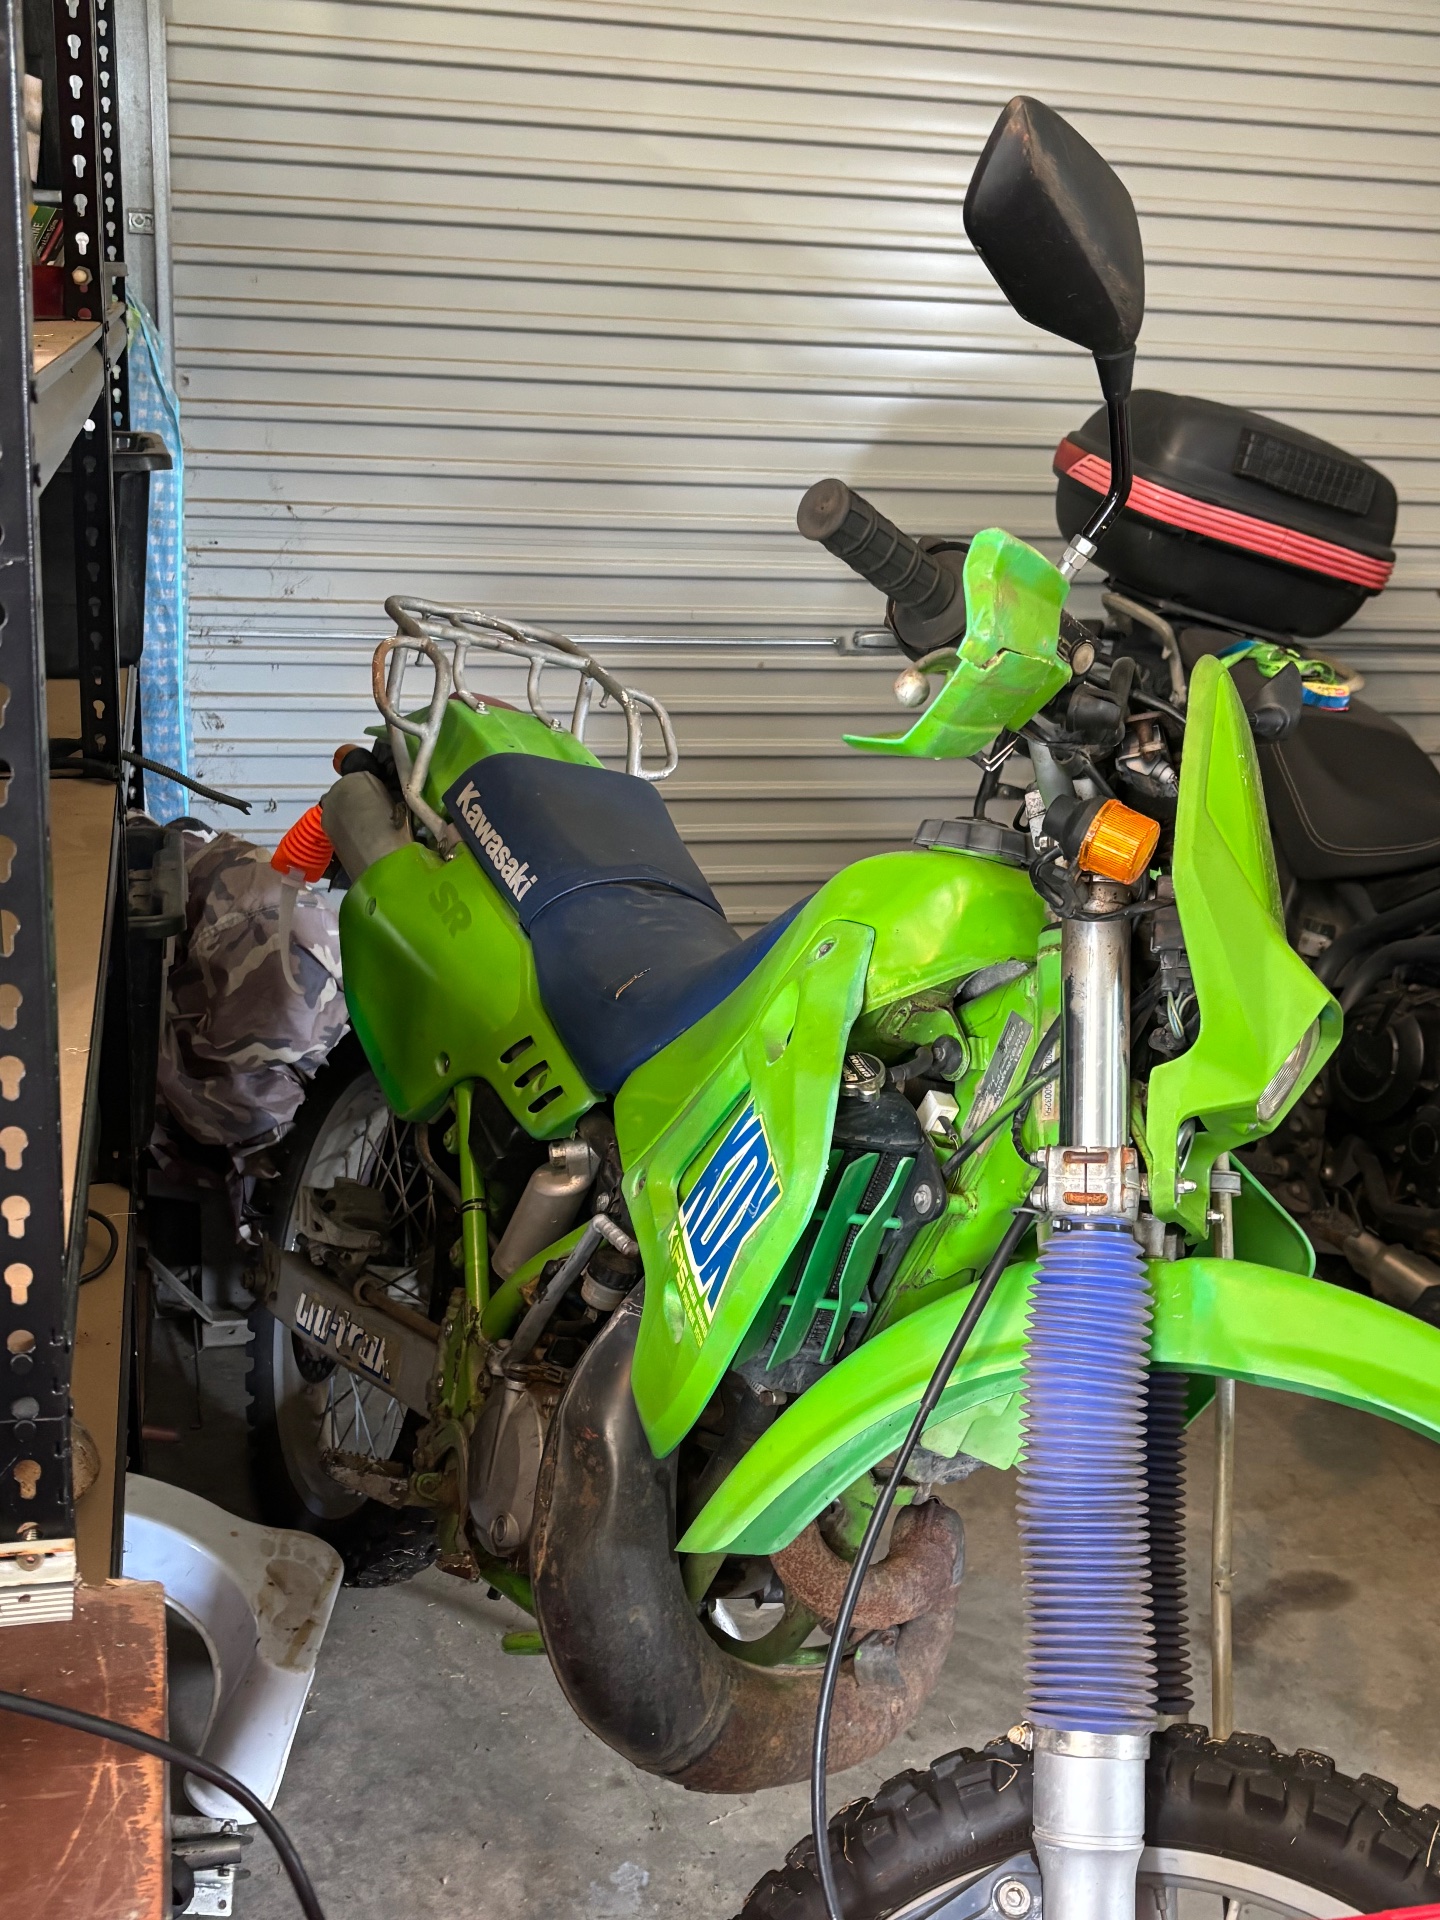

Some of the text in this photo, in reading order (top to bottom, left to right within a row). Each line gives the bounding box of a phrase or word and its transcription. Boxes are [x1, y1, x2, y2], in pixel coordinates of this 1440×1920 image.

[455, 780, 538, 902] Kawasaki
[428, 881, 472, 938] SR
[668, 1220, 689, 1293] KIPS
[679, 1097, 783, 1325] KDX
